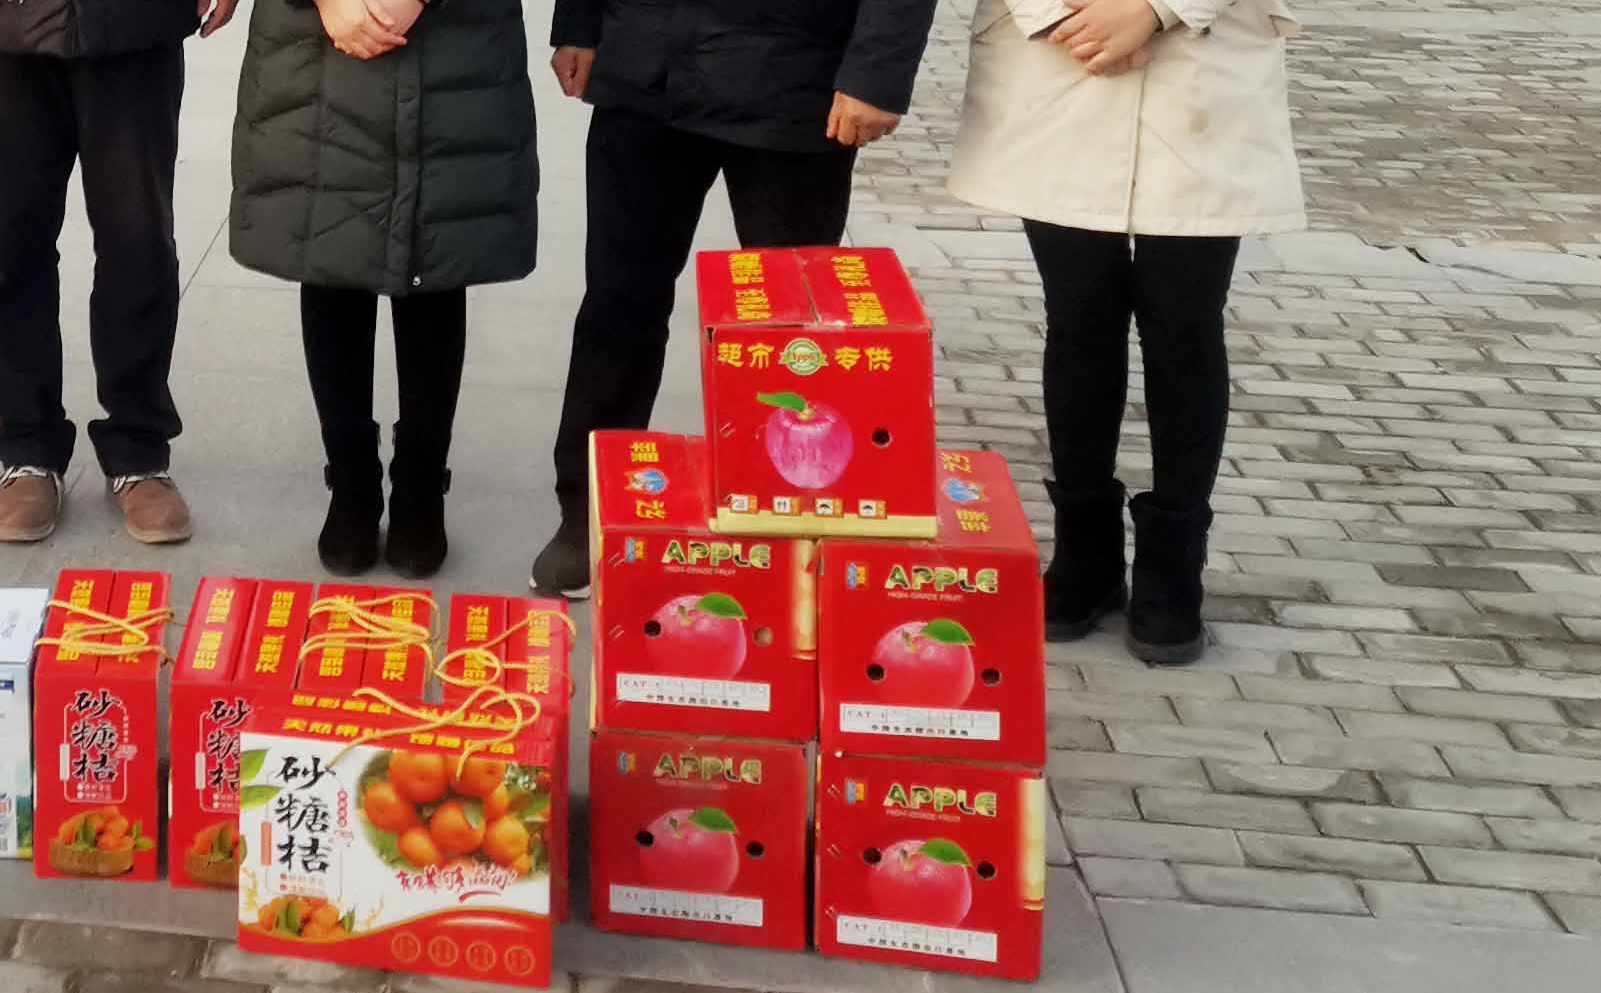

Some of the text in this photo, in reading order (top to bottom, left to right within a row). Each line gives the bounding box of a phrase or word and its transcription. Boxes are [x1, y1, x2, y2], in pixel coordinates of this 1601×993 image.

[717, 342, 775, 368] 超市
[834, 344, 894, 371] 专供
[661, 539, 771, 569] APPLE
[884, 563, 999, 594] APPLE
[71, 690, 122, 782] 砂糖桔
[654, 753, 763, 785] APPLE
[275, 755, 337, 874] 砂糖桔
[883, 782, 998, 818] APPLE
